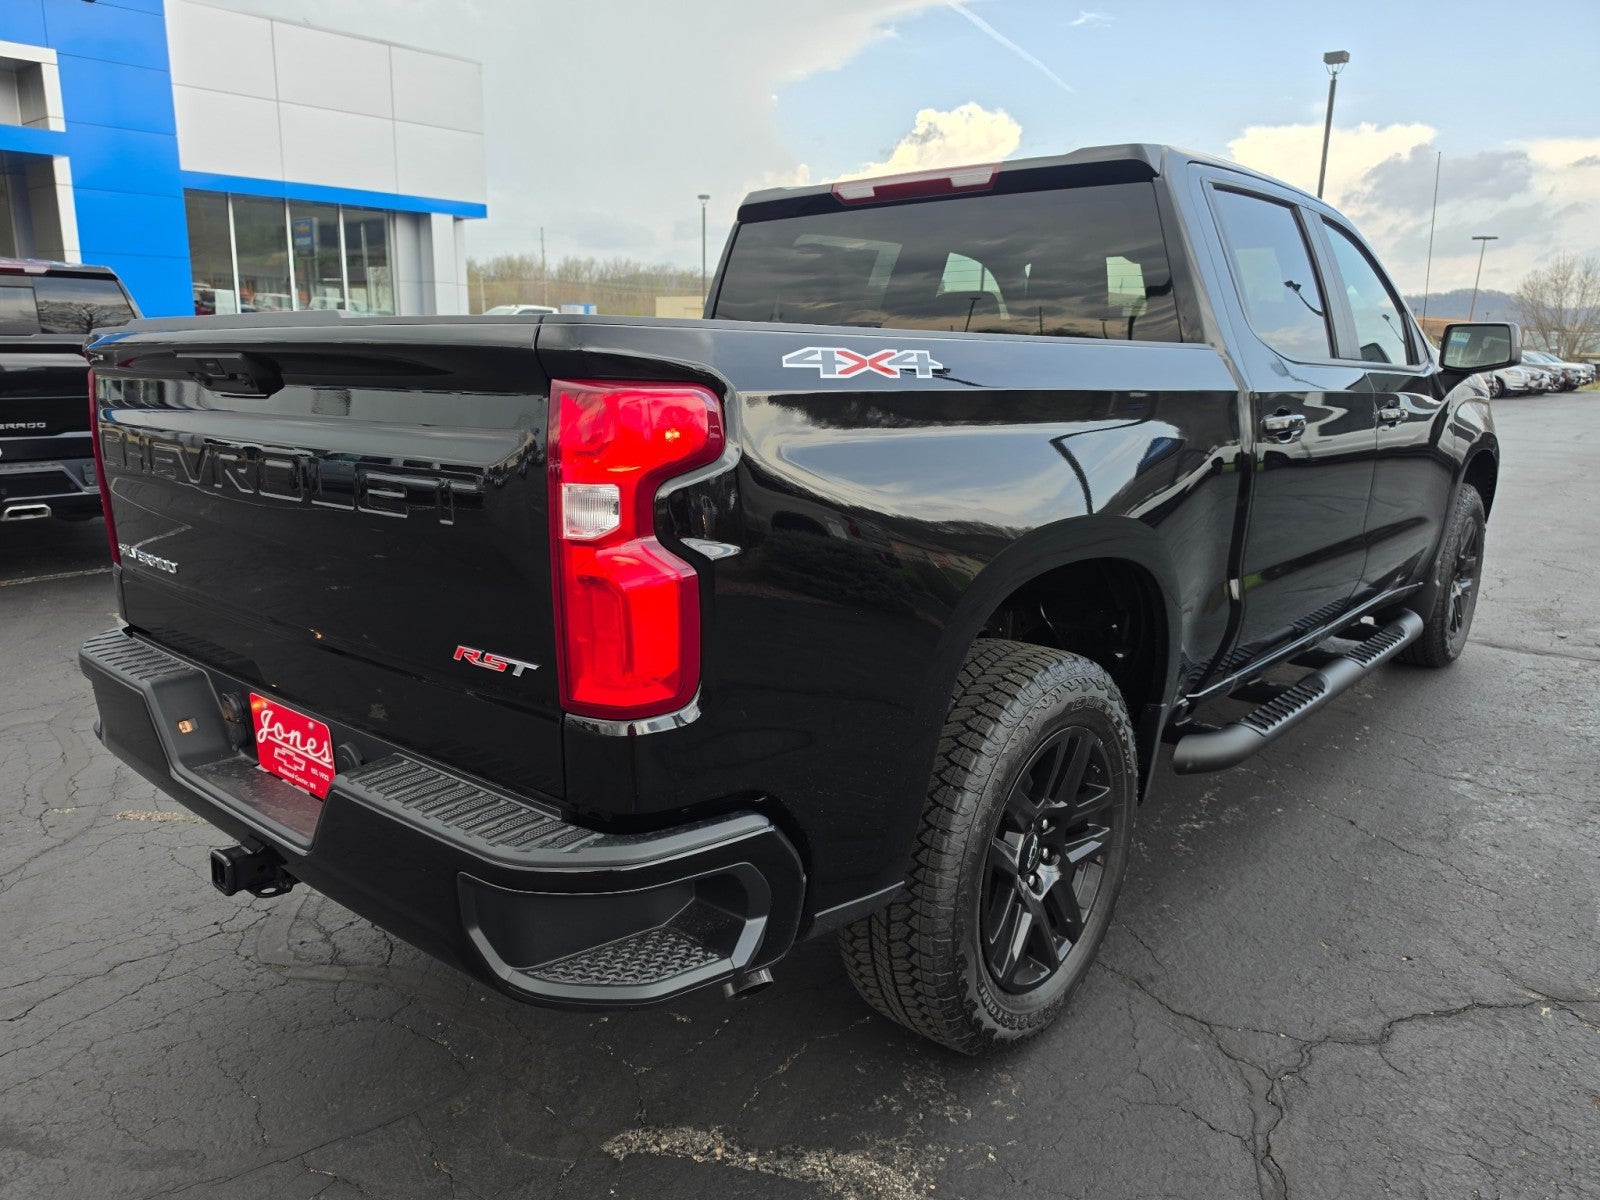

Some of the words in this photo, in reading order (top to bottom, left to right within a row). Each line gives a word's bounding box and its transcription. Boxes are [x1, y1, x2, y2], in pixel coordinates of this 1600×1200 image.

[101, 428, 484, 525] CHEVROLET
[453, 645, 541, 677] RST
[257, 709, 332, 763] Jones
